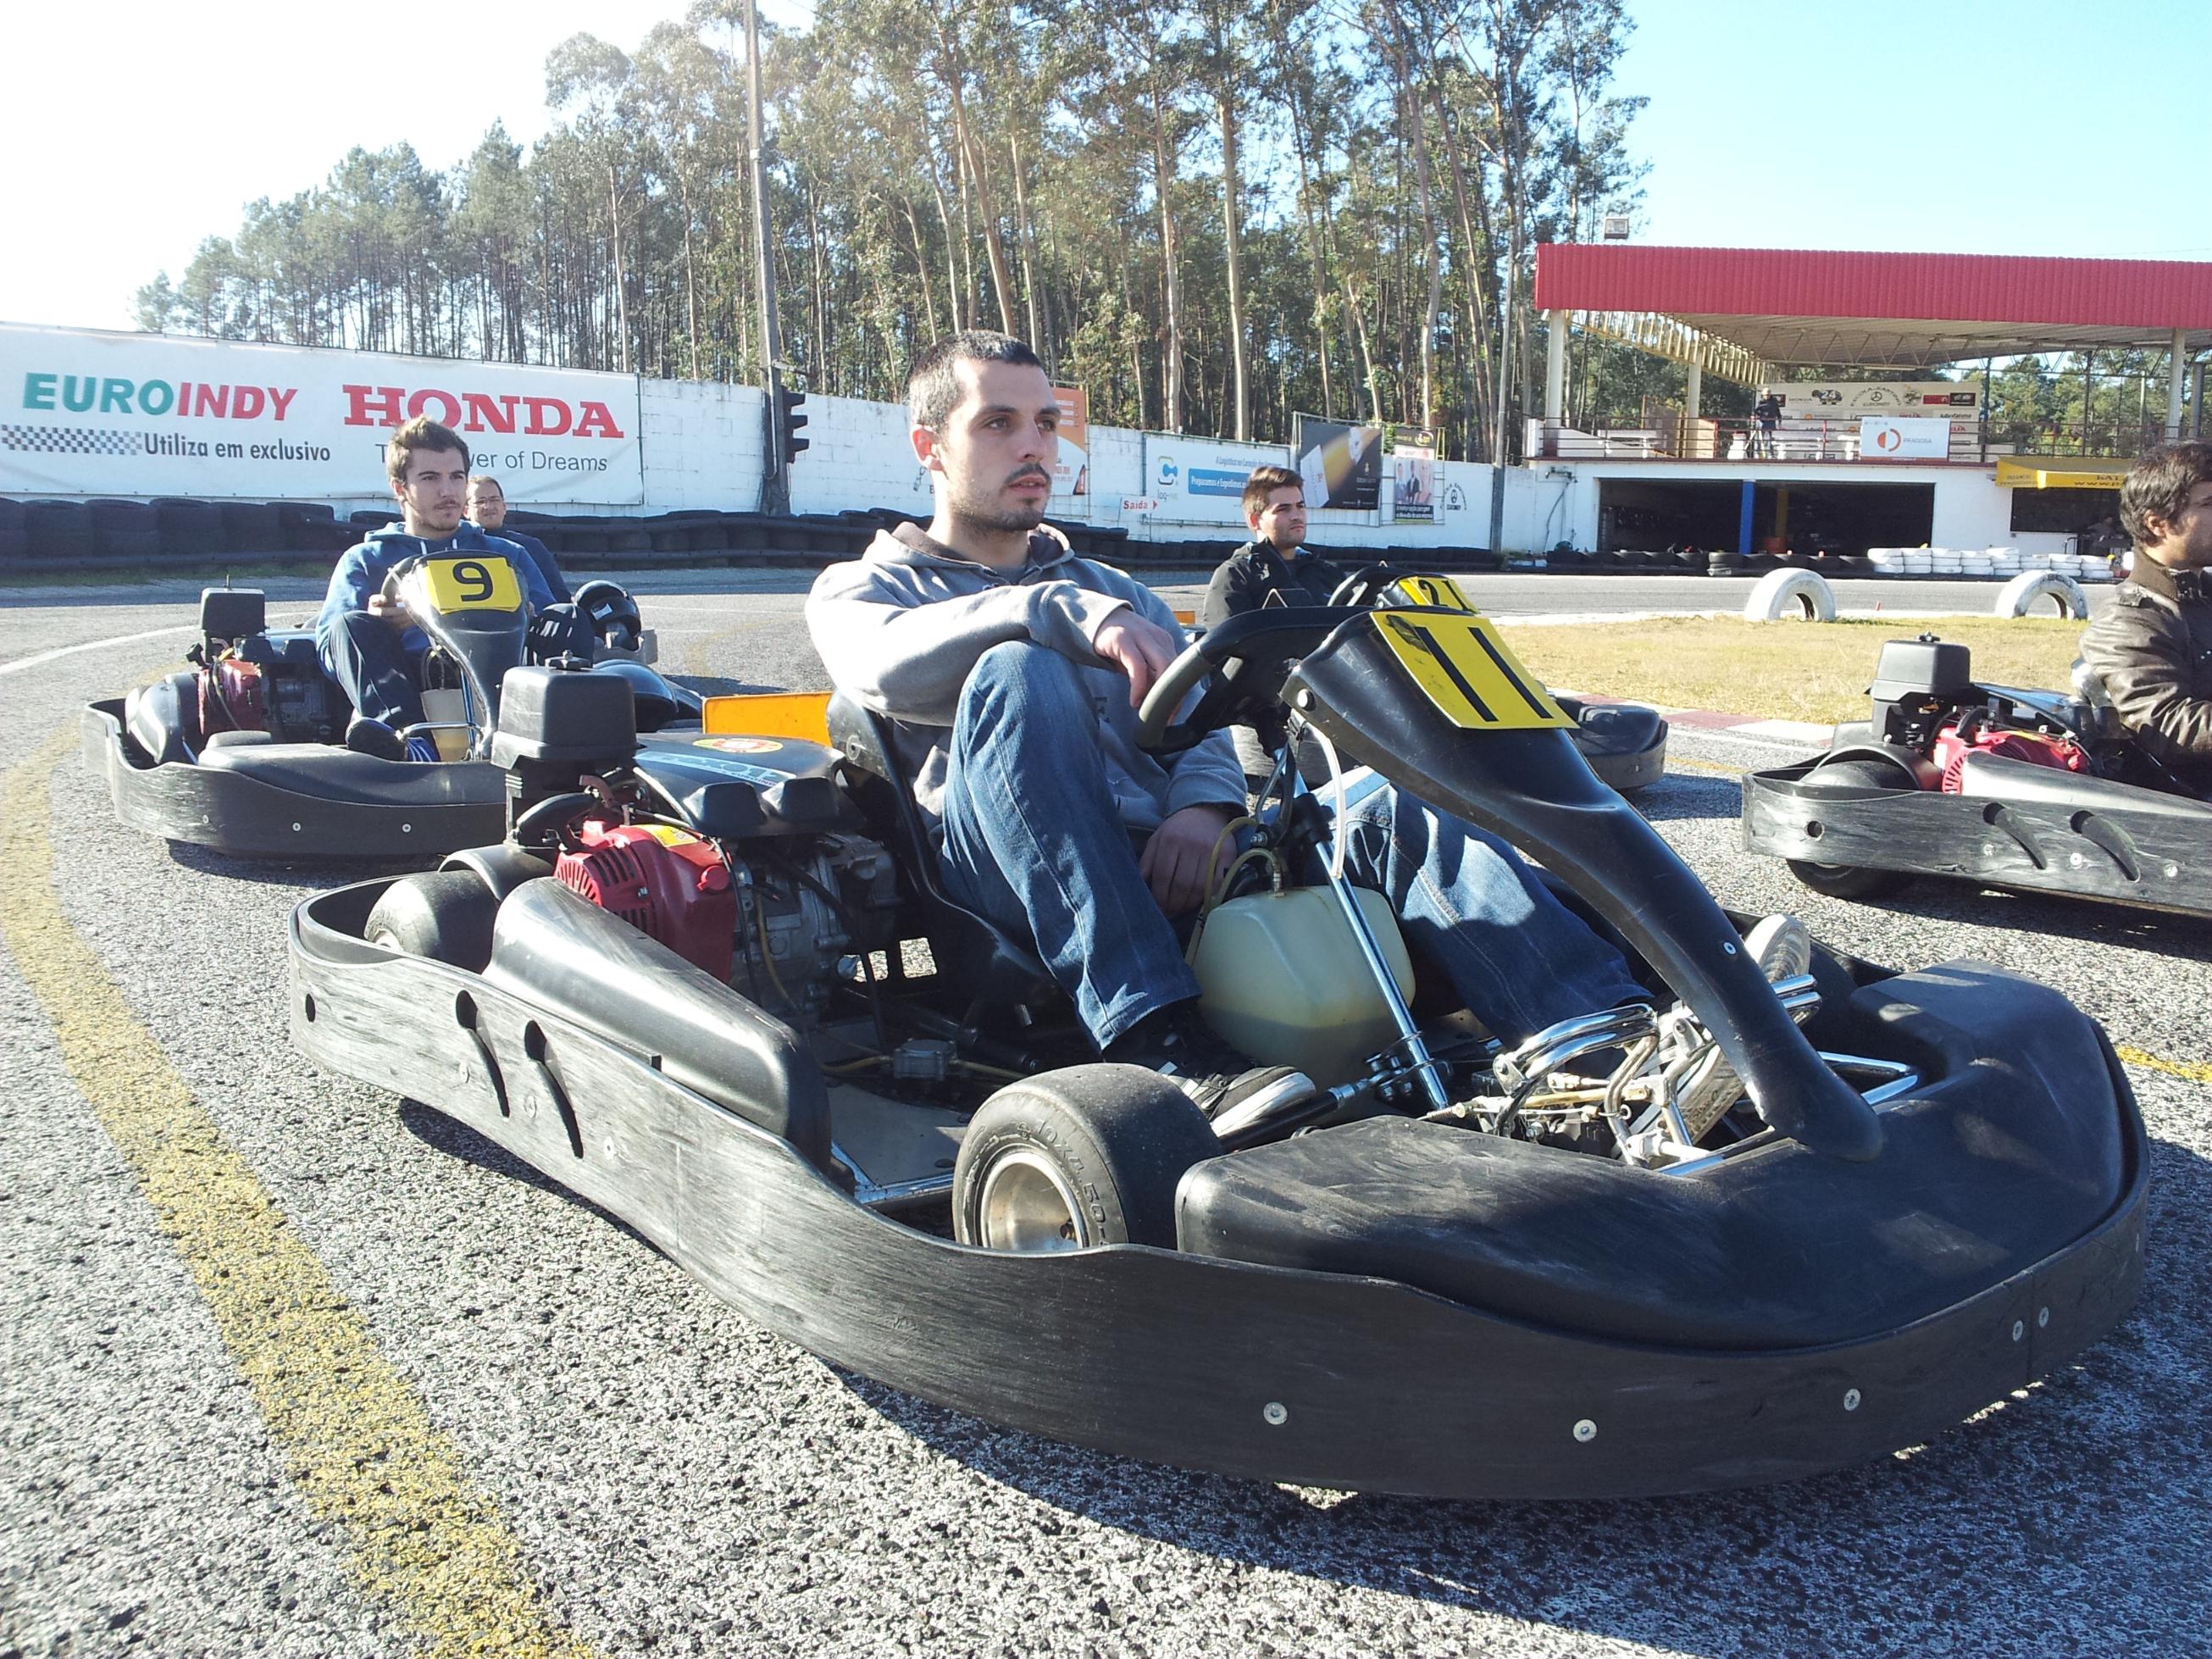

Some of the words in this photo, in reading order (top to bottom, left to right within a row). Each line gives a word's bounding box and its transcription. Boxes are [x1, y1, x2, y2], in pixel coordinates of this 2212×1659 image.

[22, 373, 298, 421] EUROINDY
[342, 385, 624, 438] HONDA
[1821, 391, 1837, 399] 24
[144, 432, 208, 457] Utiliza
[215, 442, 243, 458] em
[251, 438, 330, 461] exclusivo
[505, 452, 524, 469] of
[539, 452, 607, 471] Dreams
[452, 561, 493, 602] 9
[1417, 579, 1477, 614] 21
[1414, 626, 1553, 722] 11
